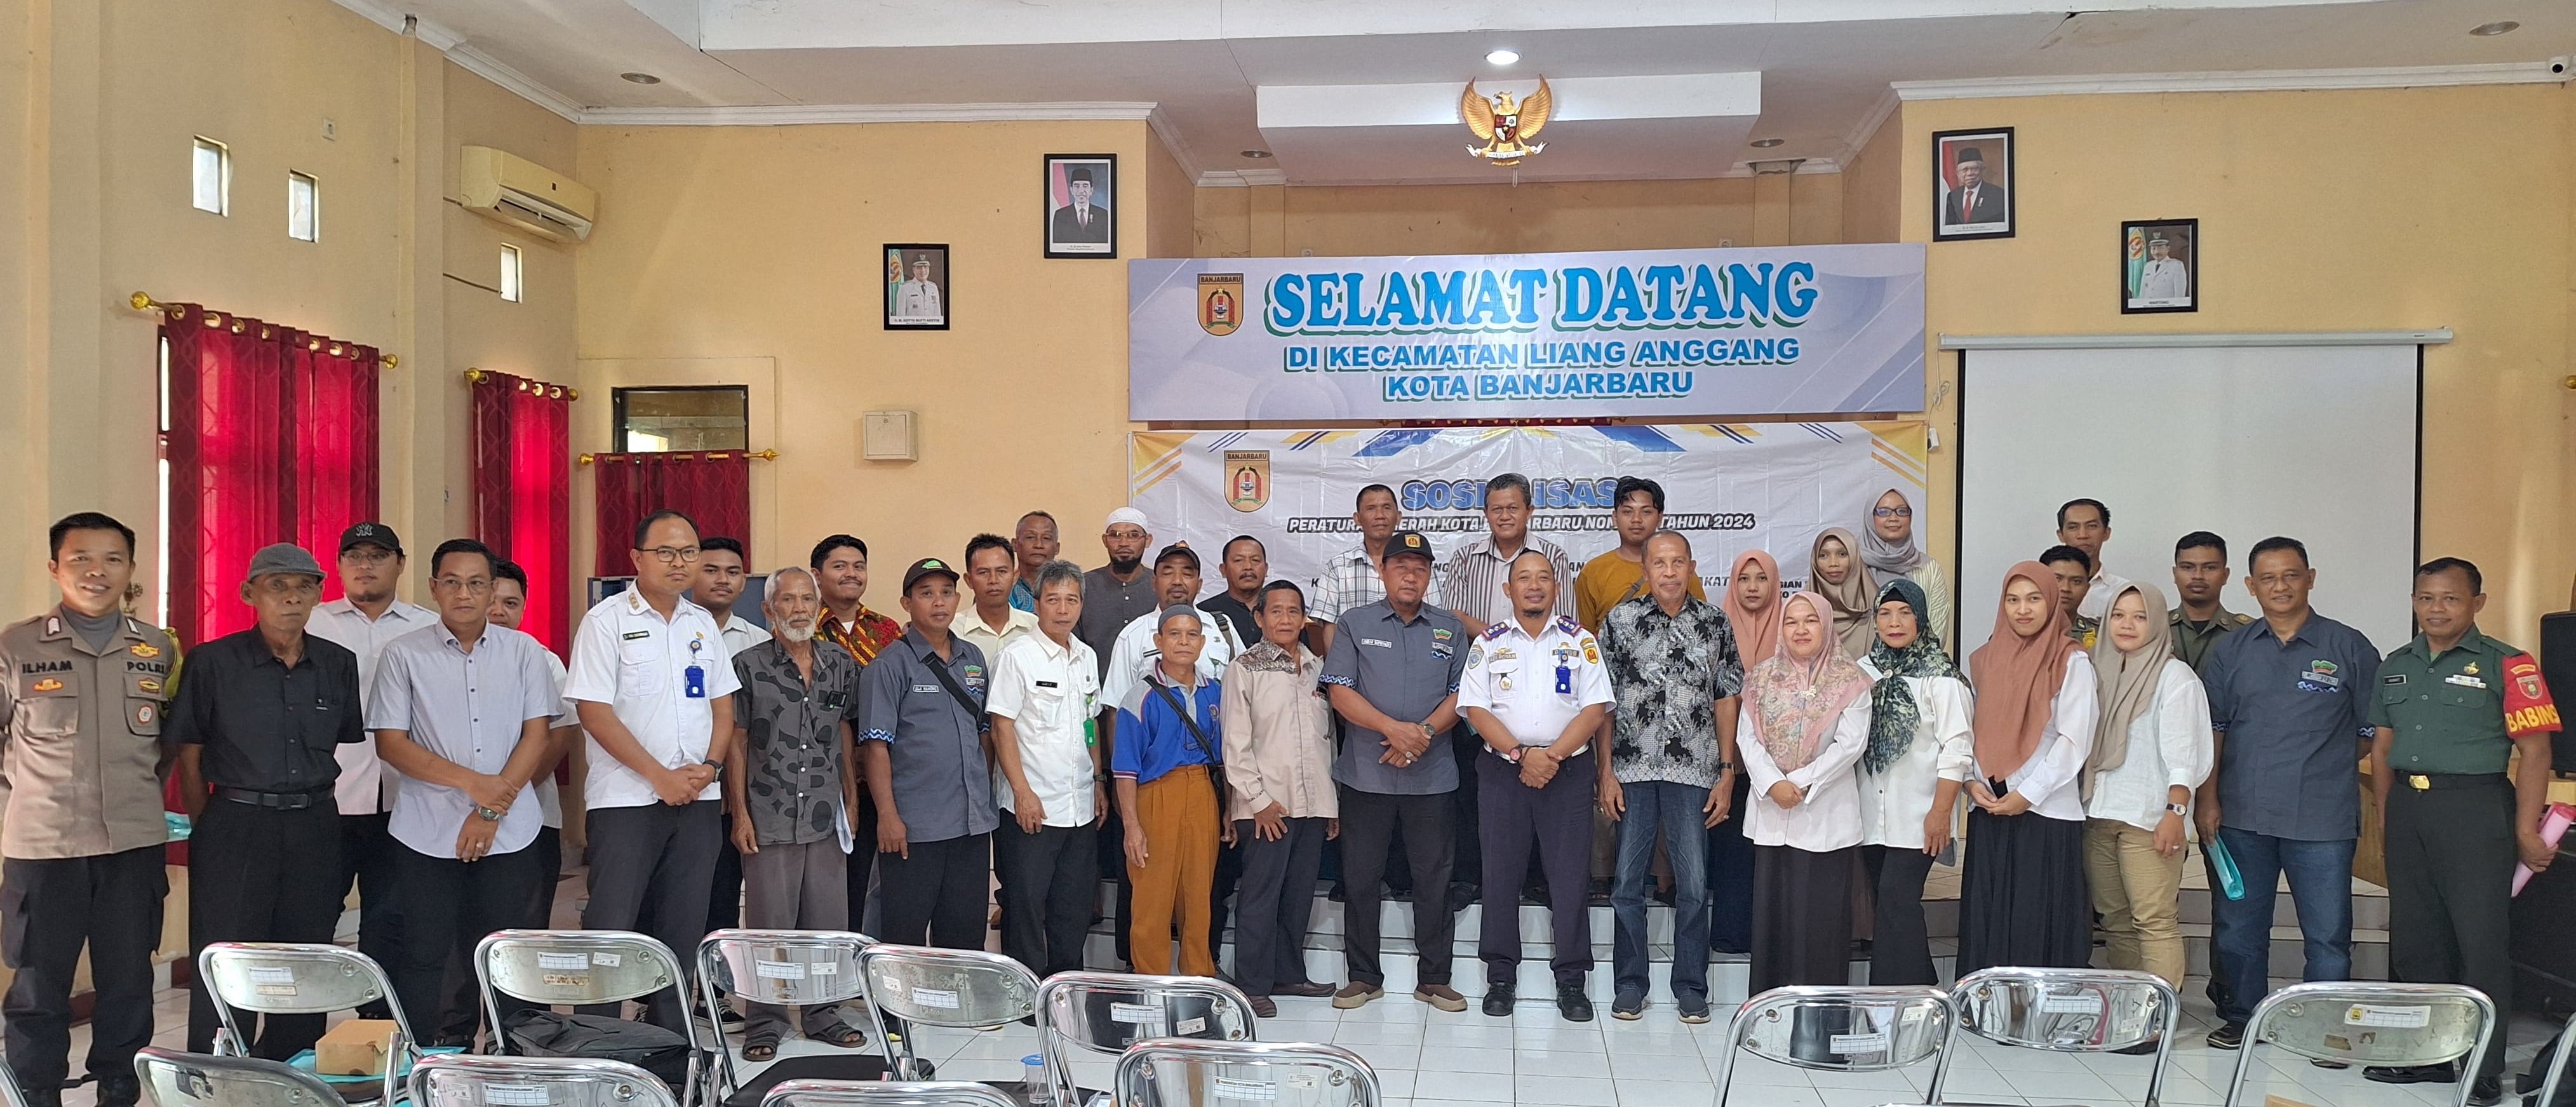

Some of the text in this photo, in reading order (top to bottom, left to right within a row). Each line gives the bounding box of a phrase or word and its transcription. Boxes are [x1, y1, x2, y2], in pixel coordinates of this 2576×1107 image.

[1271, 262, 1818, 327] SELAMAT DATANG
[1289, 337, 1799, 367] DI KECAMATAN LIANG ANGGANG
[1388, 371, 1693, 396] KOTA BANJARBARU
[1440, 518, 1482, 531] KOTA
[1660, 515, 1710, 528] TAHUN
[1712, 515, 1754, 528] 2024
[22, 660, 73, 674] ILHAM
[127, 661, 165, 674] POLRI
